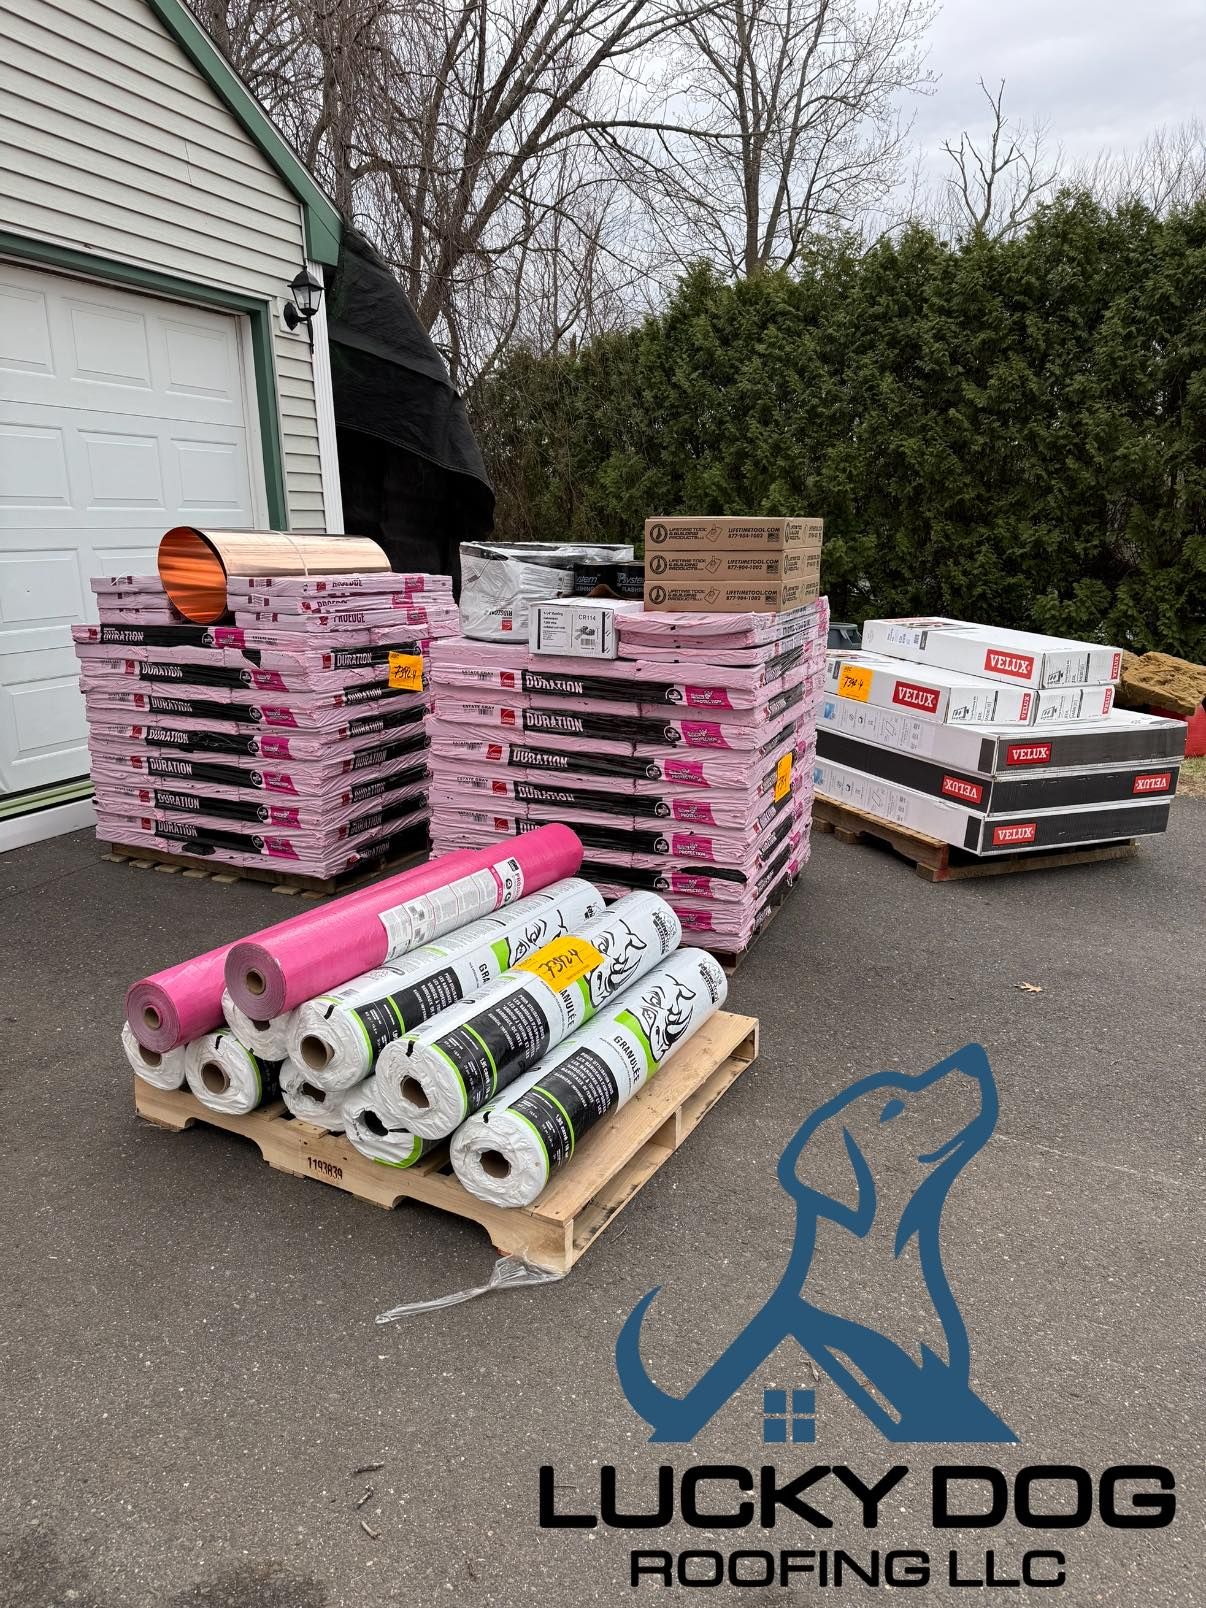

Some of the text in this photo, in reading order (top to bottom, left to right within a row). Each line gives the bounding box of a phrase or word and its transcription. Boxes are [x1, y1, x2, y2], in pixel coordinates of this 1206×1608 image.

[336, 652, 372, 666] DURATION
[990, 654, 1028, 674] VELUX
[142, 662, 183, 677] DURATION
[526, 674, 583, 694] DURATION
[151, 698, 193, 712] DURATION
[898, 687, 934, 707] VELUX
[1103, 690, 1111, 714] VELUX
[1021, 696, 1030, 720] VELUX
[526, 713, 583, 732] DURATION
[149, 729, 189, 743] DURATION
[513, 748, 568, 767] DURATION
[1012, 747, 1047, 760] VELUX
[150, 758, 192, 775] DURATION
[945, 782, 977, 798] VELUX
[1138, 778, 1167, 789] VELUX
[157, 793, 199, 809] DURATION
[518, 786, 575, 801] DURATION
[158, 820, 198, 837] DURATION
[998, 826, 1033, 840] VELUX
[612, 1035, 641, 1083] GRANULÉE
